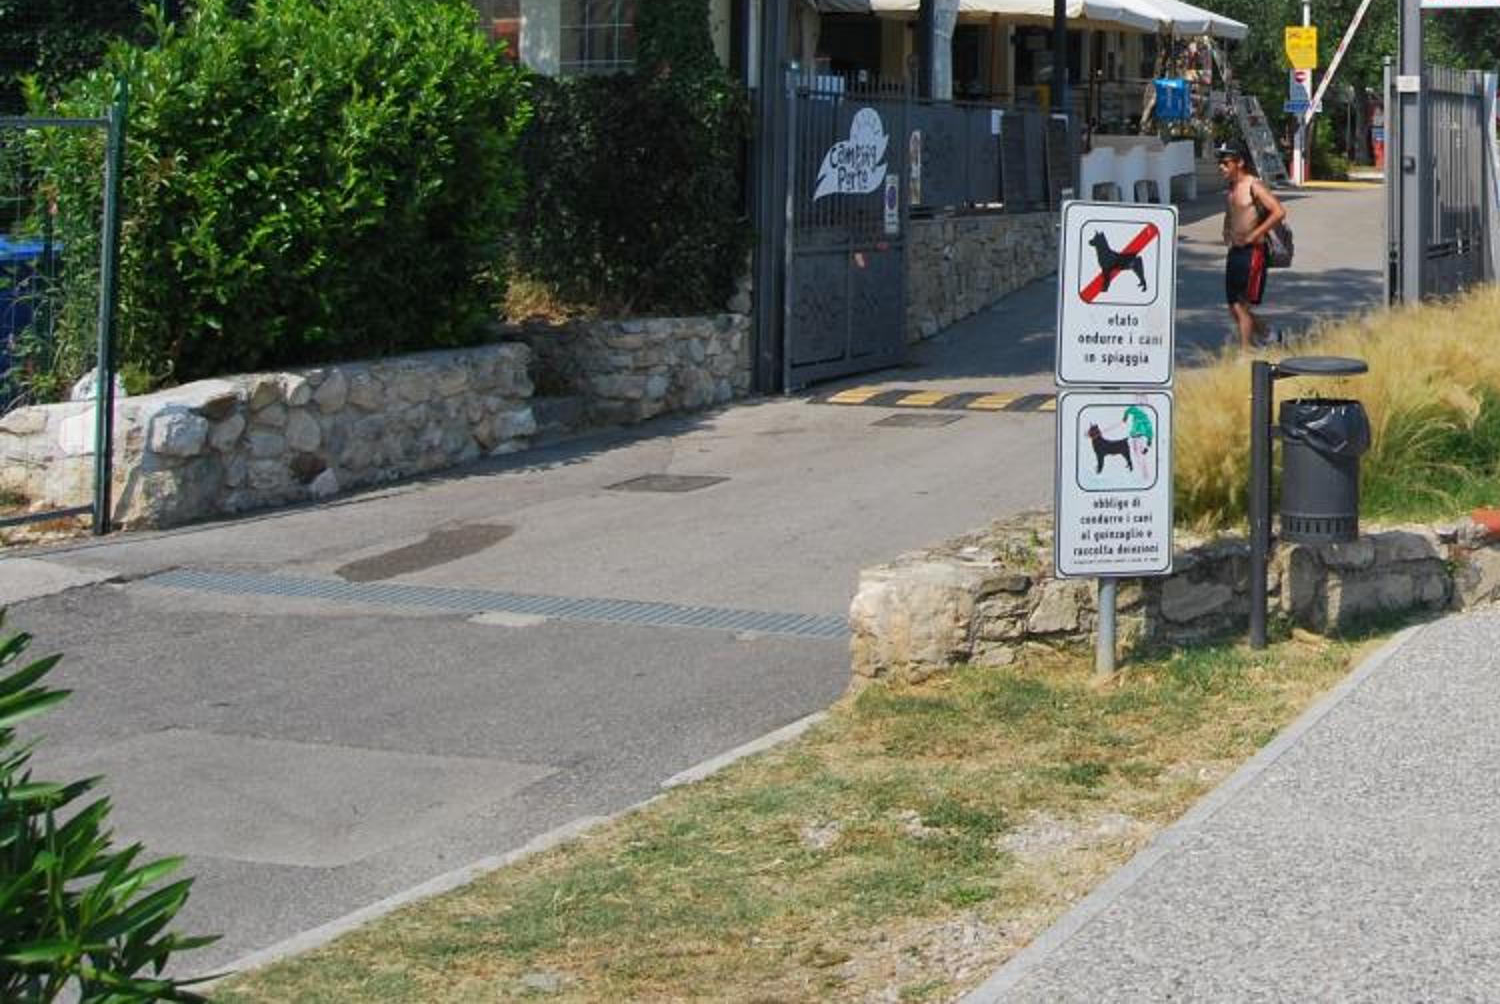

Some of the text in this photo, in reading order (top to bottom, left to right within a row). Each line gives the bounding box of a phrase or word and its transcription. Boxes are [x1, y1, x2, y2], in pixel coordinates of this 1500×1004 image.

[1138, 332, 1163, 346] cani
[1084, 351, 1149, 367] in spiaggia
[1093, 497, 1141, 511] obbligo di
[1079, 511, 1123, 525] condurre
[1133, 511, 1153, 524] cani
[1081, 530, 1091, 541] al
[1093, 528, 1144, 543] guinzaglio
[1073, 542, 1159, 557] raccolta deiezioni
